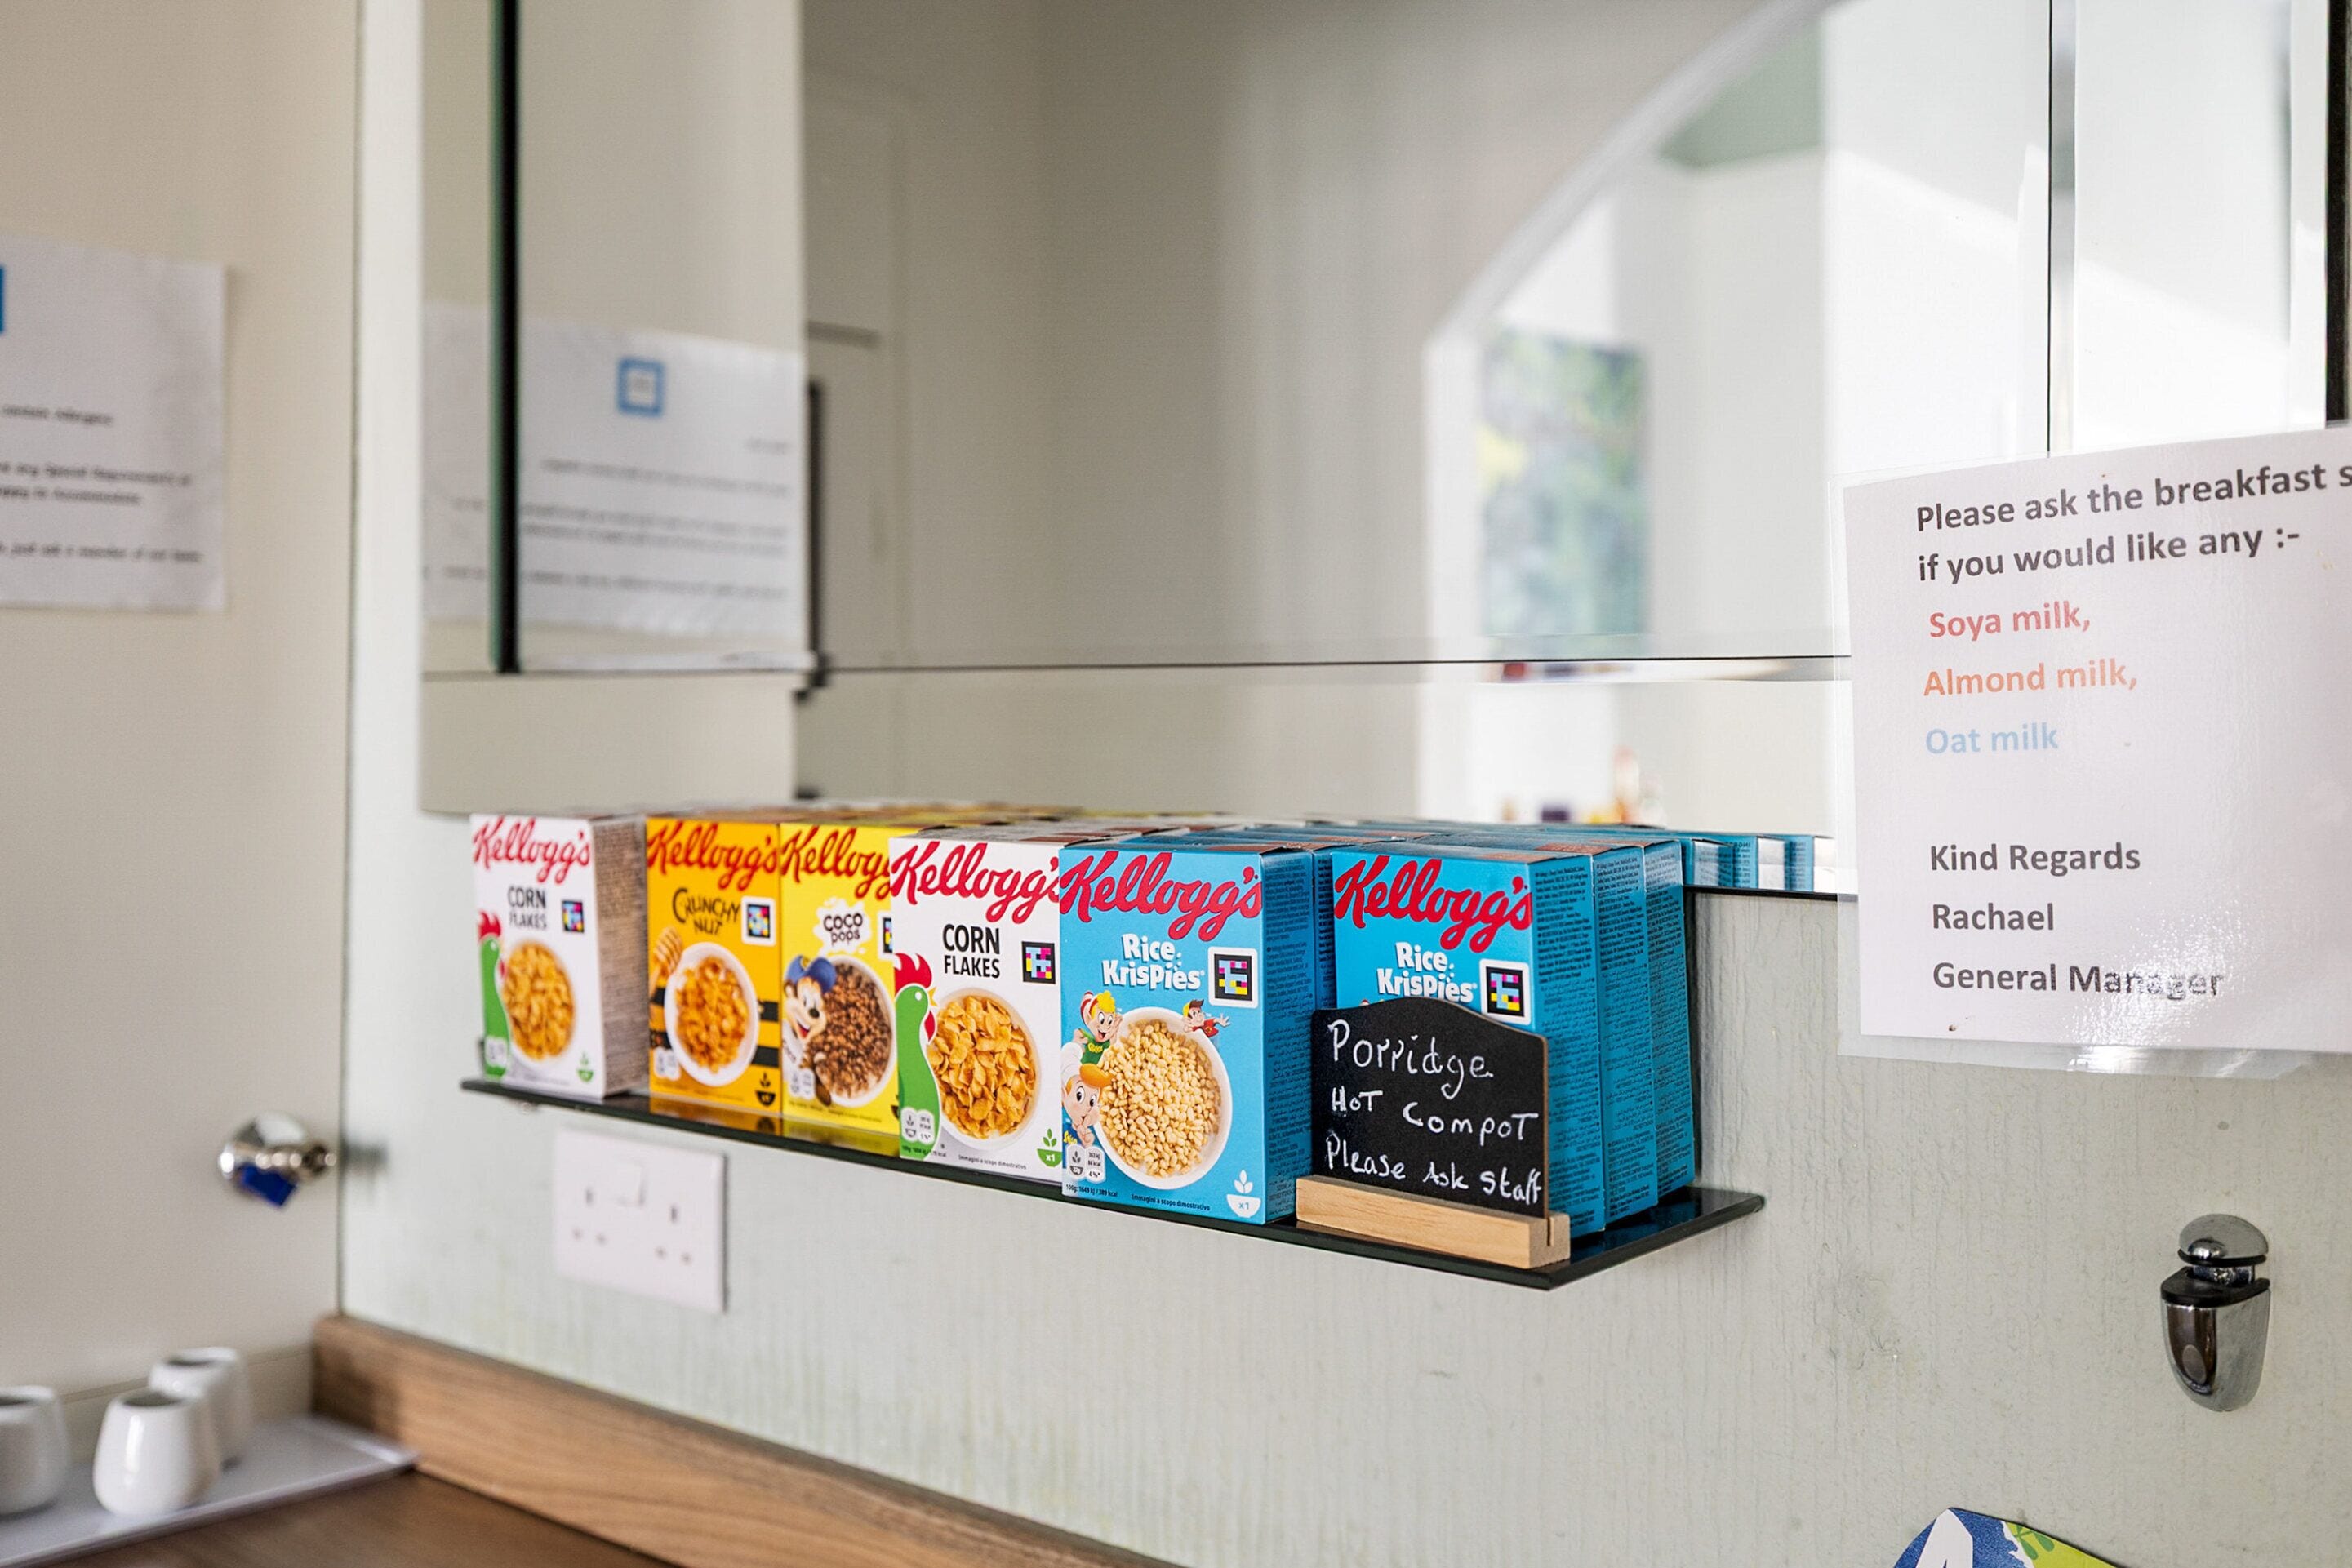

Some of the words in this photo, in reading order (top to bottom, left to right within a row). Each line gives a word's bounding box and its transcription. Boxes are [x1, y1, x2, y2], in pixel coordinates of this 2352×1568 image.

[1917, 504, 2015, 532] Please
[2025, 488, 2079, 521] ask
[2087, 484, 2144, 513] the
[2155, 464, 2327, 507] breakfast
[1919, 553, 1939, 581] if
[1947, 552, 2004, 584] you
[2014, 535, 2115, 571] would
[2127, 531, 2187, 562] like
[2199, 528, 2263, 557] any
[1929, 611, 2001, 642] Soya
[2012, 600, 2091, 633] milk,
[1923, 662, 2045, 696] Almond
[2057, 657, 2137, 691] milk,
[1926, 727, 1981, 755] Oat
[1990, 722, 2060, 752] milk
[472, 816, 590, 885] Kellogg's
[647, 820, 780, 892] Kellogg's
[1931, 842, 1999, 871] Kind
[2009, 842, 2141, 877] Regards
[507, 885, 547, 909] CORN
[1060, 851, 1263, 942] Kellogg's
[1333, 855, 1533, 953] Kellogg's
[509, 909, 548, 931] FLAKES
[693, 917, 723, 937] NUT
[1932, 902, 2055, 931] Rachael
[942, 922, 1001, 956] CORN
[1121, 932, 1176, 962] Rice
[943, 953, 1001, 979] FLAKES
[1394, 940, 1448, 973] Rice
[1932, 962, 2057, 992] General
[1327, 1019, 1494, 1100] Porridge
[1326, 1130, 1406, 1179] Please
[1422, 1161, 1469, 1191] Ask
[1132, 1193, 1156, 1204] Immagini
[1161, 1198, 1177, 1208] scopo
[1176, 1198, 1211, 1211] dimostrativo
